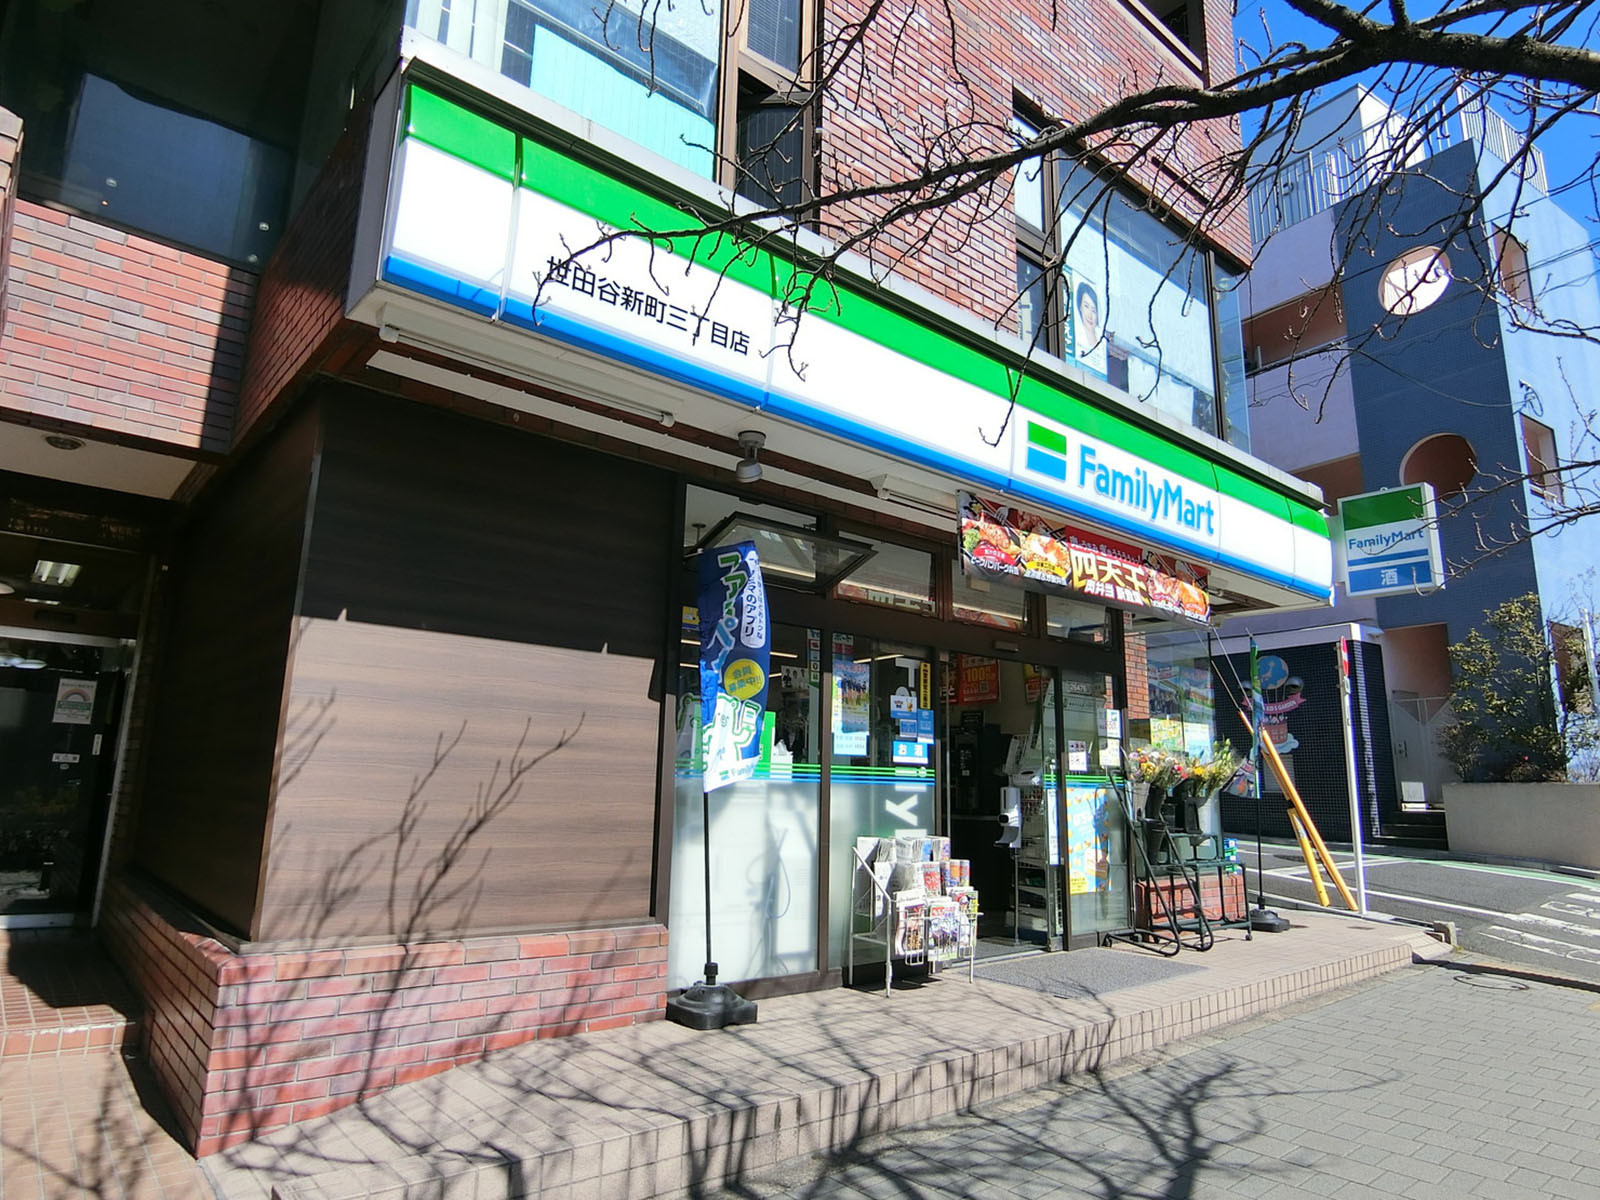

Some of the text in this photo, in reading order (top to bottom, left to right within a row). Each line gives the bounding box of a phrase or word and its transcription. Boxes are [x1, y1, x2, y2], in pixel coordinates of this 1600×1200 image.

[546, 256, 750, 356] 世田谷新町三丁目店
[1079, 443, 1214, 536] FamilyMart
[1348, 529, 1424, 550] FamilyMart
[1380, 568, 1398, 586] 酒
